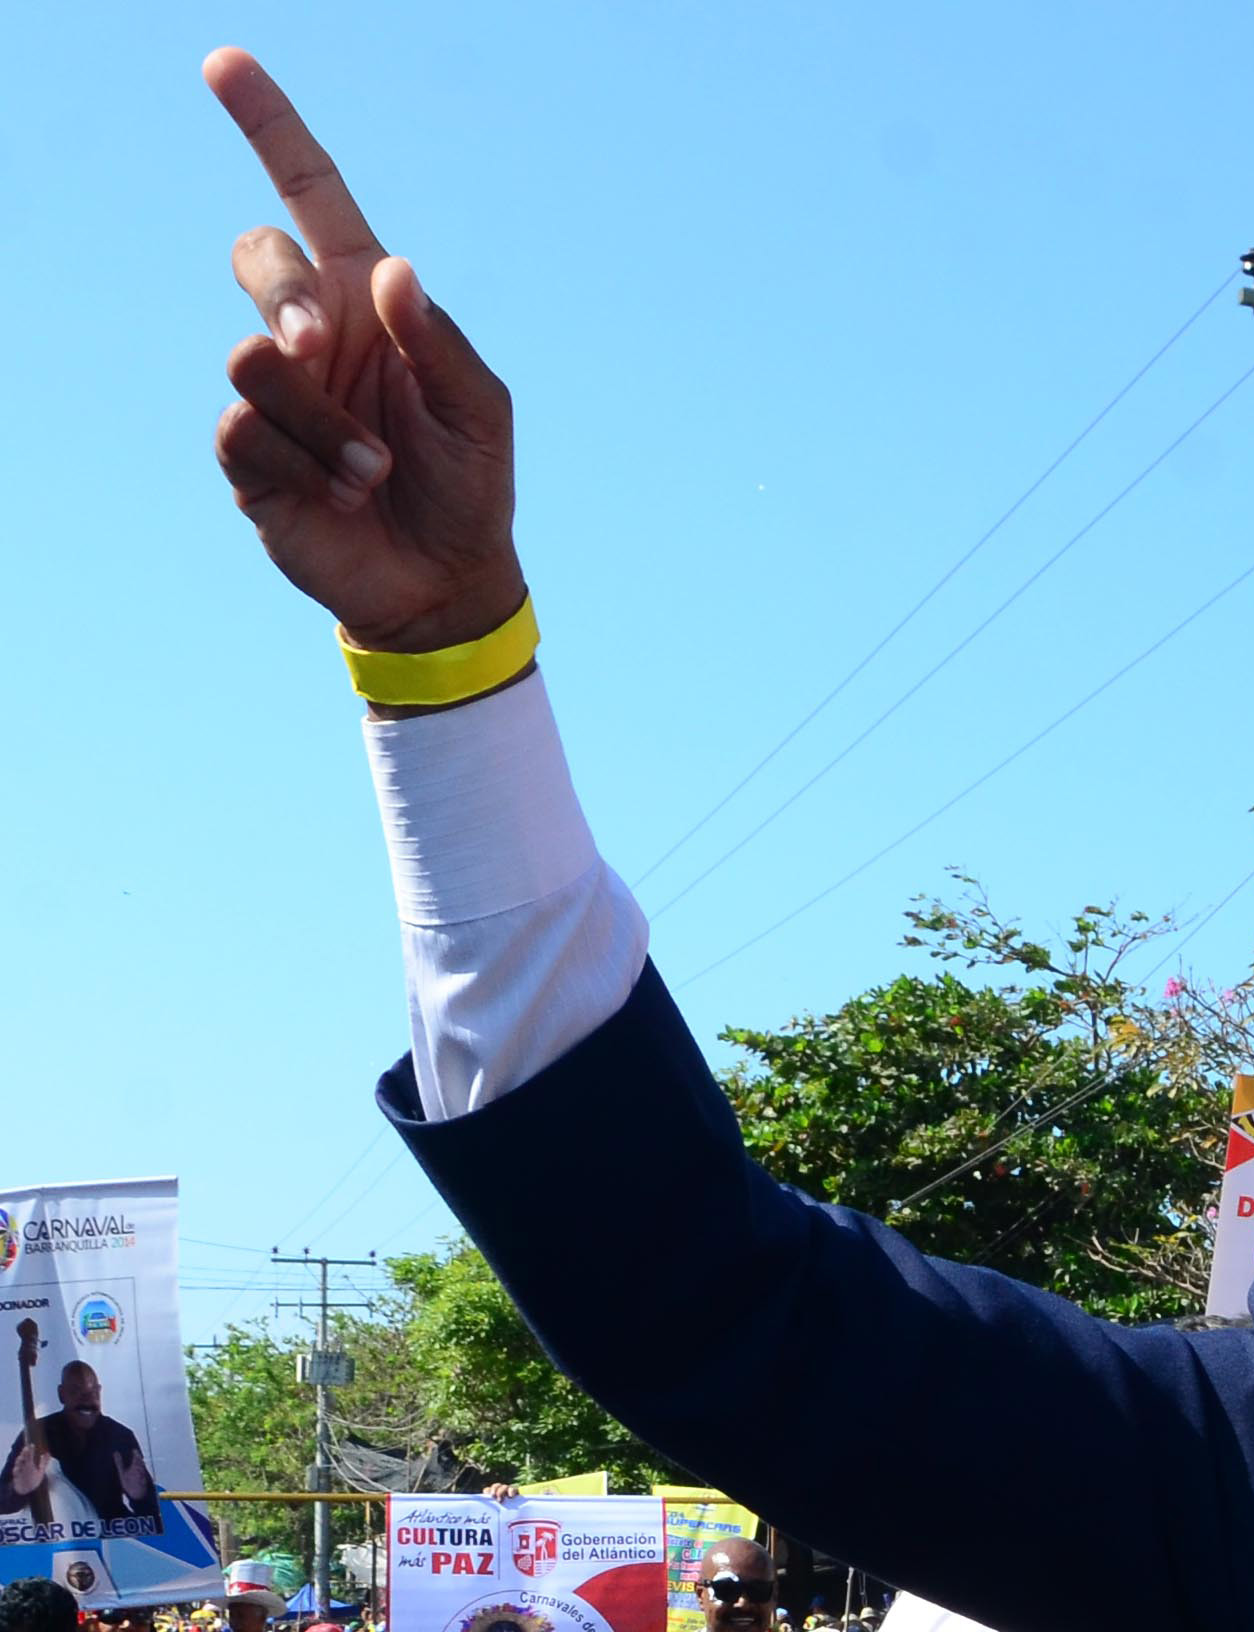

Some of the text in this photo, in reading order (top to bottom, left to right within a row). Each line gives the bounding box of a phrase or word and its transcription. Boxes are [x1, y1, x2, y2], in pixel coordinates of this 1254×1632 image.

[23, 1215, 135, 1241] CARNAVAL
[25, 1238, 108, 1254] BARRANQUILLA
[71, 1521, 96, 1538] DE
[100, 1516, 156, 1538] LEON
[397, 1526, 493, 1546] CULTURA
[561, 1532, 656, 1546] Gobernación
[431, 1552, 494, 1575] PAZ
[562, 1547, 656, 1560] del Atlántico
[519, 1591, 584, 1623] Carnavales
